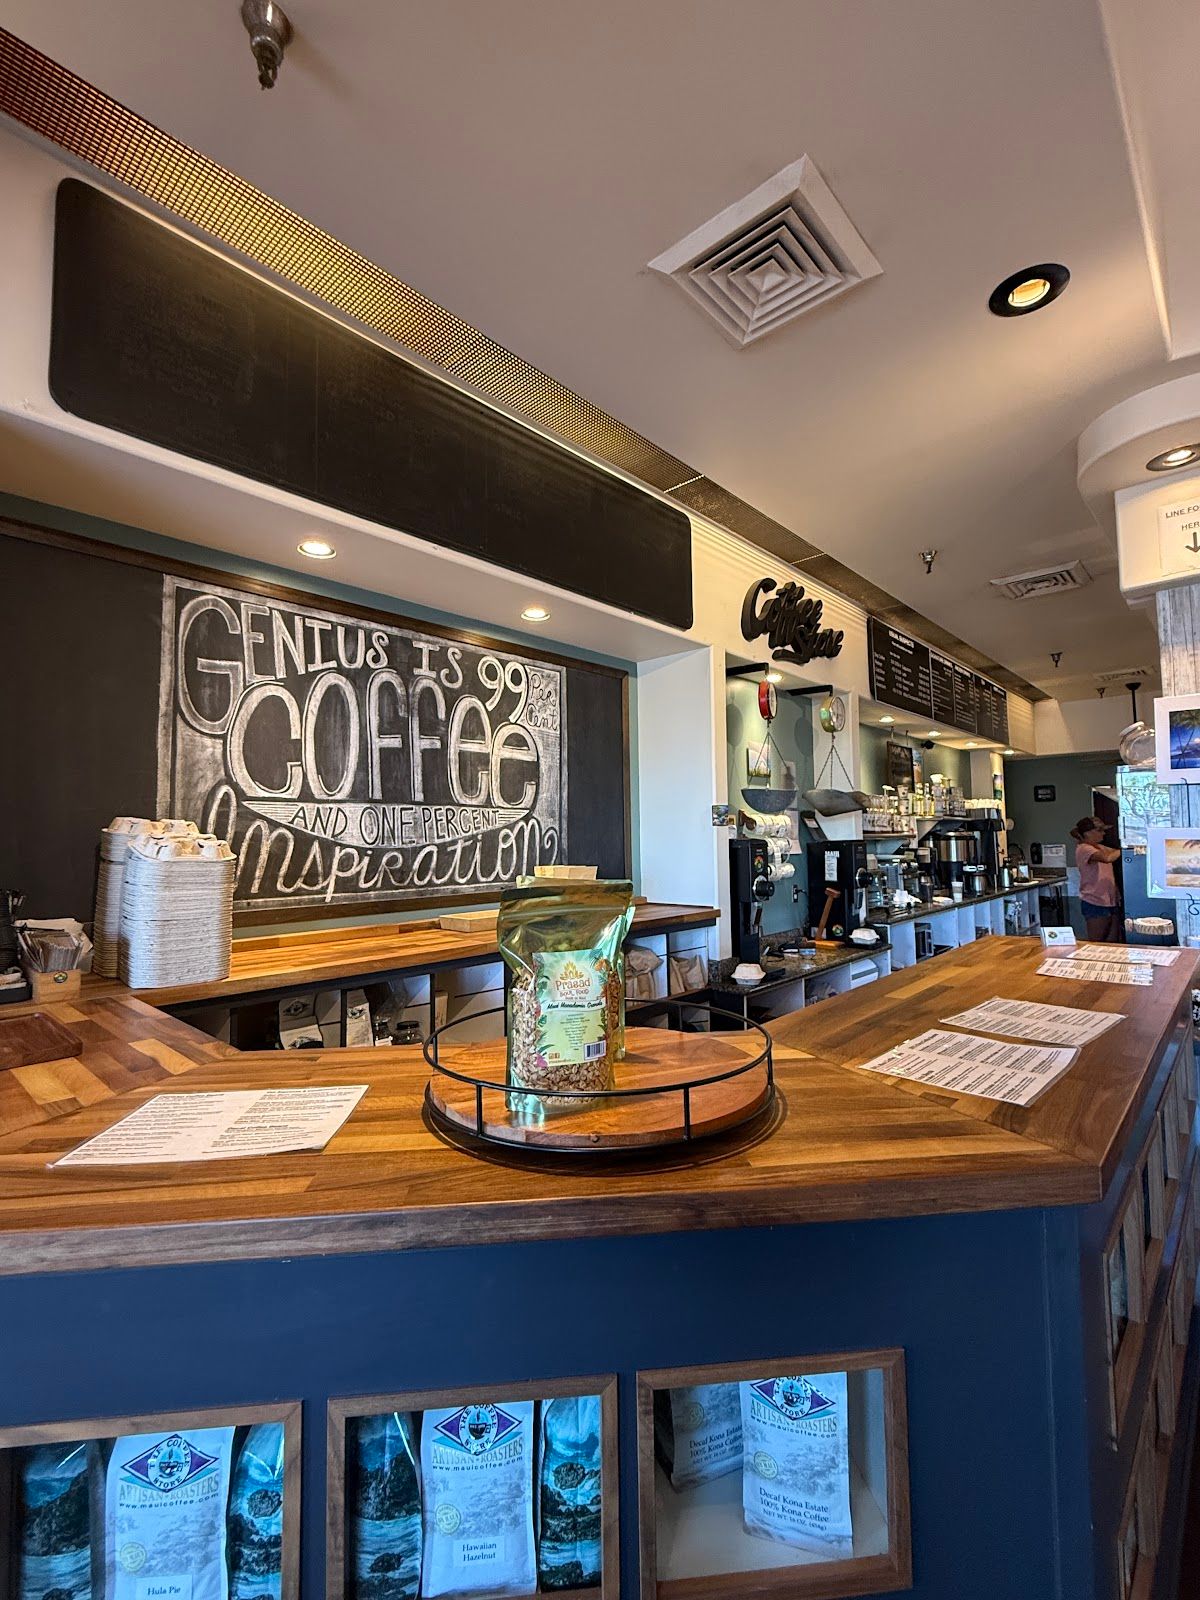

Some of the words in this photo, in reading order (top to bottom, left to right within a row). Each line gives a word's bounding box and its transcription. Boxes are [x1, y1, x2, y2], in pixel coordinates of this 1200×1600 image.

[1166, 508, 1185, 518] LINE
[1188, 505, 1200, 513] FO
[1182, 521, 1200, 532] HER
[178, 594, 391, 735] GENIUS
[413, 640, 462, 688] IS
[478, 656, 528, 723] 99
[288, 805, 348, 840] AND
[360, 806, 414, 846] ONE
[423, 806, 499, 840] PERCENT
[556, 978, 590, 990] Prasad
[780, 1404, 806, 1417] STORE
[460, 1408, 472, 1430] THE
[465, 1437, 491, 1450] SRE
[709, 1432, 725, 1443] Kona
[760, 1486, 780, 1500] Decaf
[782, 1495, 802, 1508] Kona
[805, 1502, 828, 1513] Estate
[760, 1497, 780, 1510] 100%
[782, 1505, 802, 1517] Kona
[804, 1510, 829, 1522] Coffee
[462, 1542, 497, 1552] Hawaiian
[464, 1552, 496, 1562] Hazelnut
[148, 1586, 166, 1596] Hula
[168, 1586, 181, 1594] Pie
